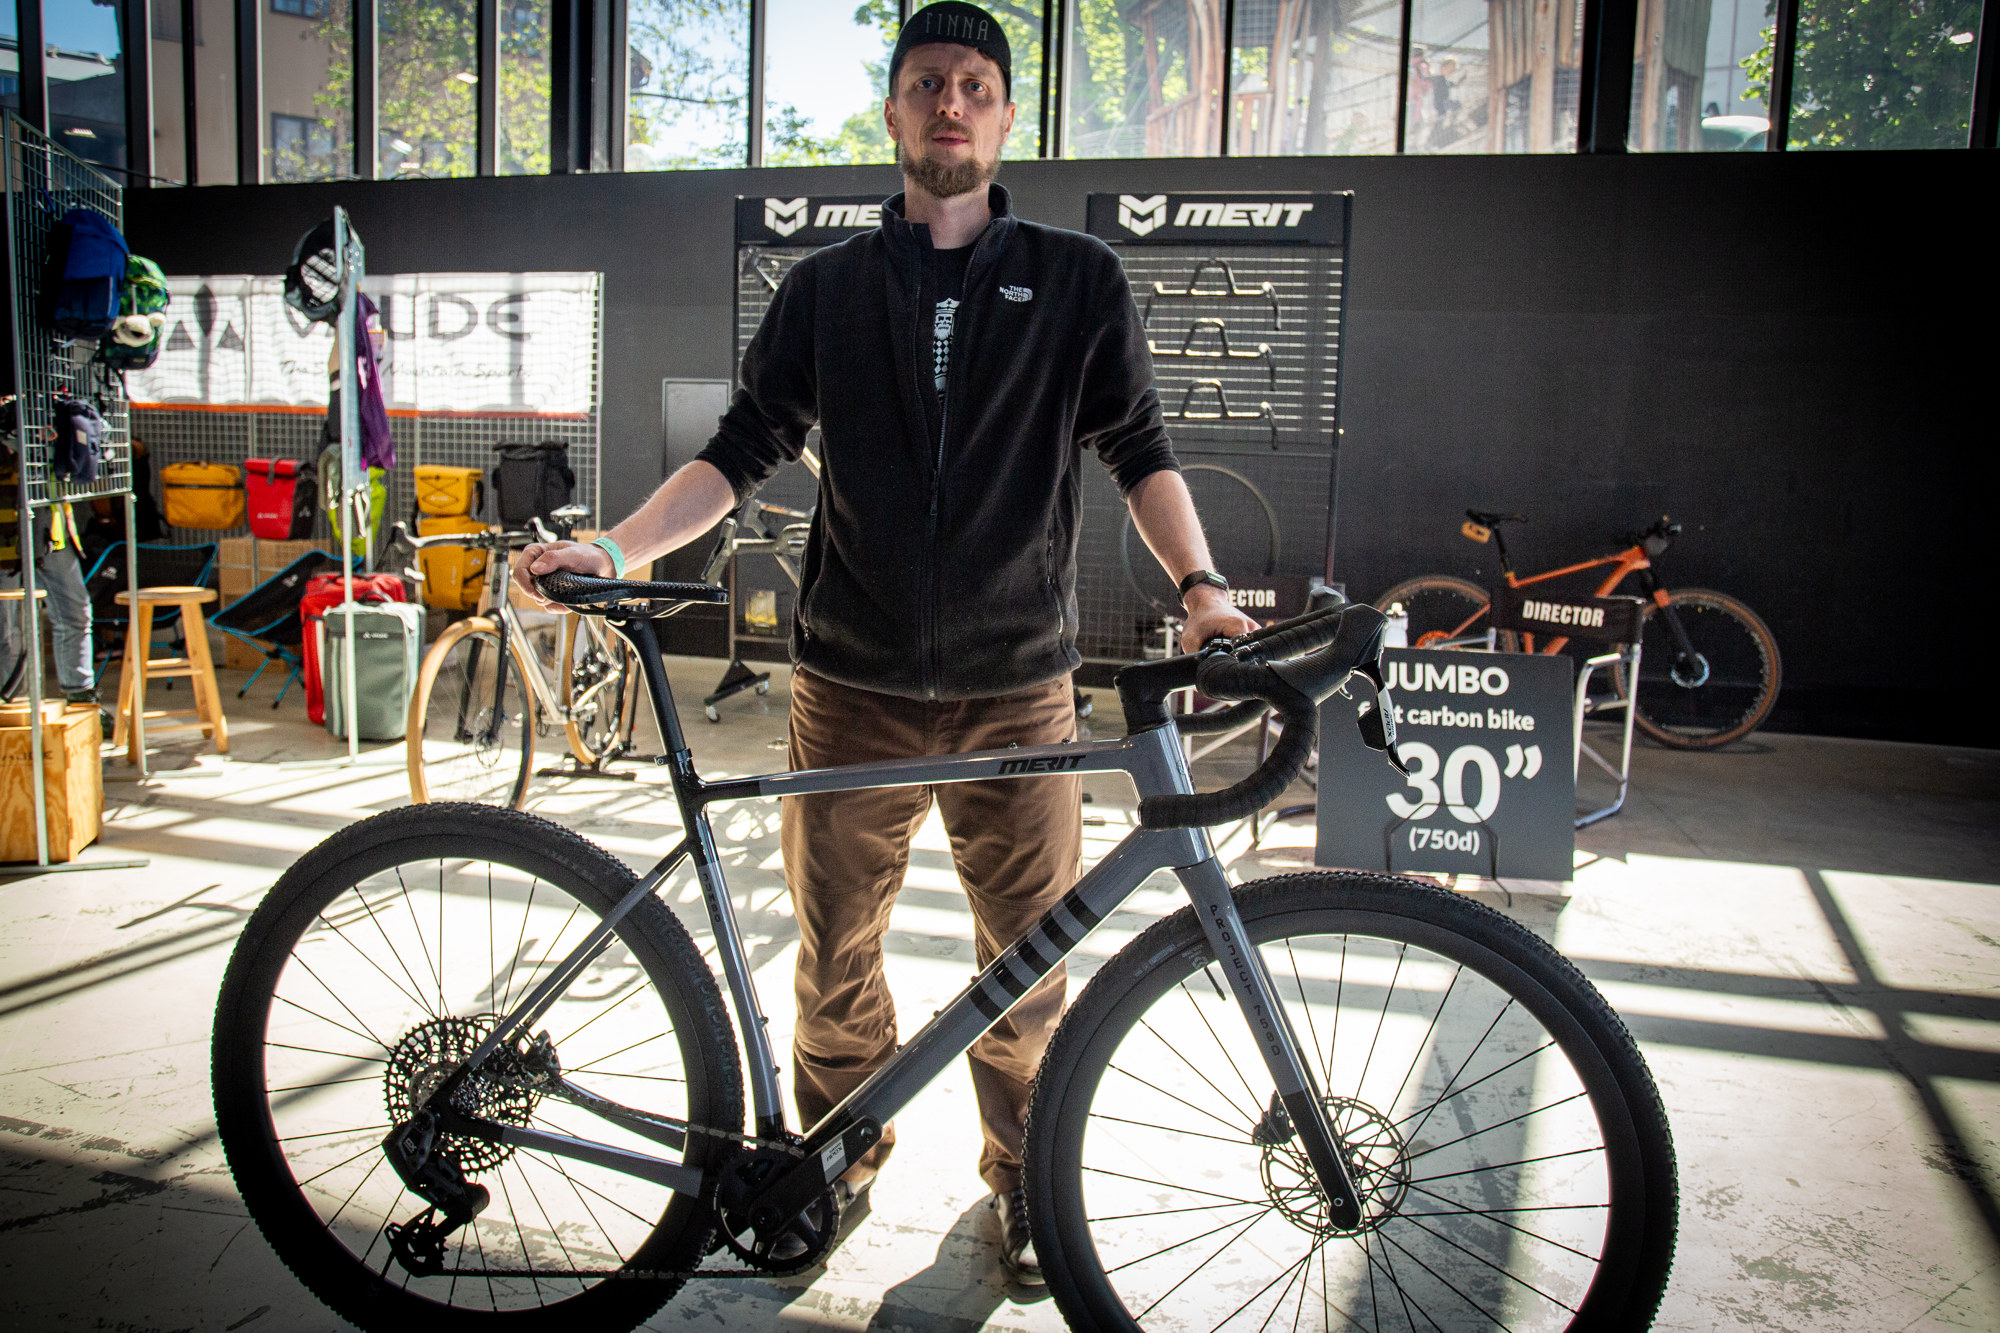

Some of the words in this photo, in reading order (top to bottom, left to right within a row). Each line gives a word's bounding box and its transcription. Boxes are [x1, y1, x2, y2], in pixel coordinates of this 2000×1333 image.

[925, 12, 989, 41] FINNA
[1173, 203, 1314, 227] MERIT
[999, 286, 1023, 297] NORTH
[283, 292, 532, 341] VUDE
[1228, 589, 1276, 607] ECTOR
[1522, 600, 1605, 627] DIRECTOR
[1386, 661, 1510, 696] JUMBO
[1407, 705, 1484, 728] carbon
[1487, 708, 1535, 731] bike
[998, 755, 1087, 775] MERIT
[1409, 826, 1480, 856] (750d)
[703, 873, 721, 923] JUMBO
[1210, 904, 1252, 996] PROJECT
